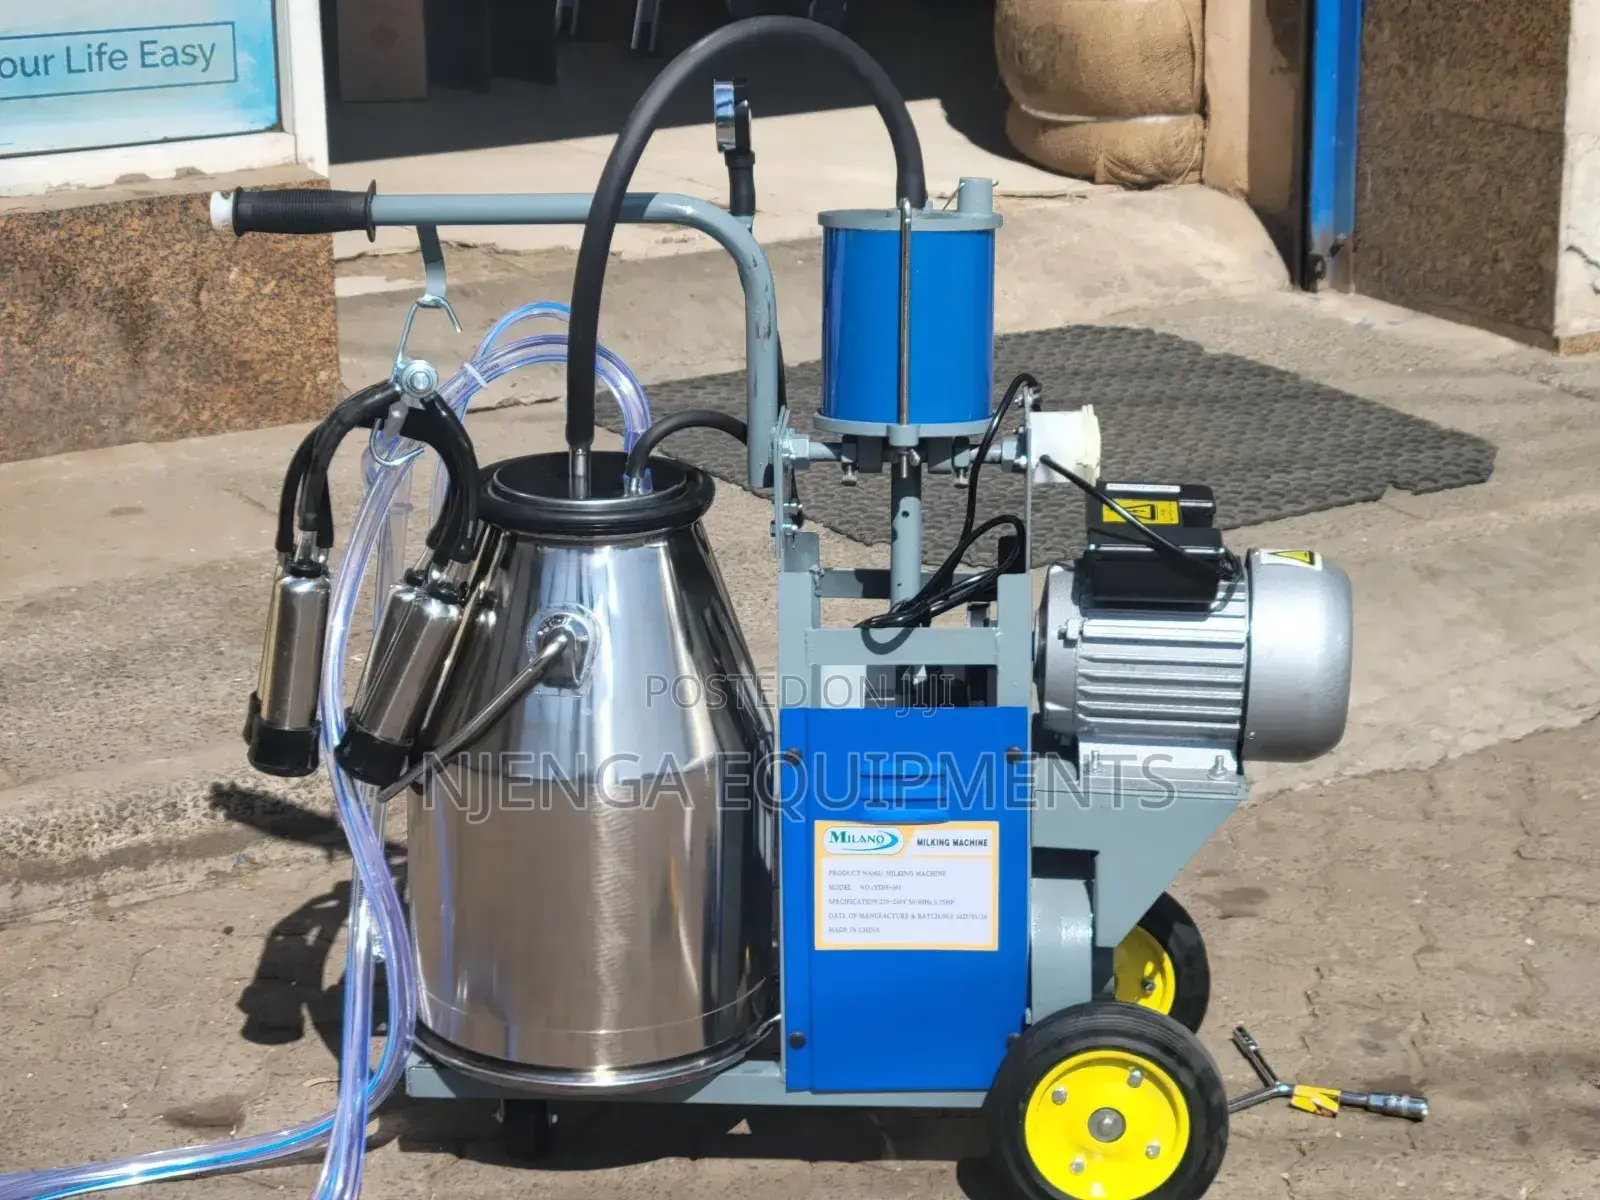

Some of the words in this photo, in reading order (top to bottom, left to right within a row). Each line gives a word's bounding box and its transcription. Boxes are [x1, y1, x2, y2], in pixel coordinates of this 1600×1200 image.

[65, 42, 129, 74] Life
[139, 40, 216, 73] Easy
[917, 838, 950, 847] MILKING
[952, 838, 989, 847] MACHINE
[828, 869, 861, 877] PRODUCT
[885, 870, 914, 878] MILKING
[915, 870, 947, 878] MACHINE
[848, 912, 858, 920] OF
[859, 912, 909, 920] MANUFACTURE
[858, 926, 880, 934] CHINA
